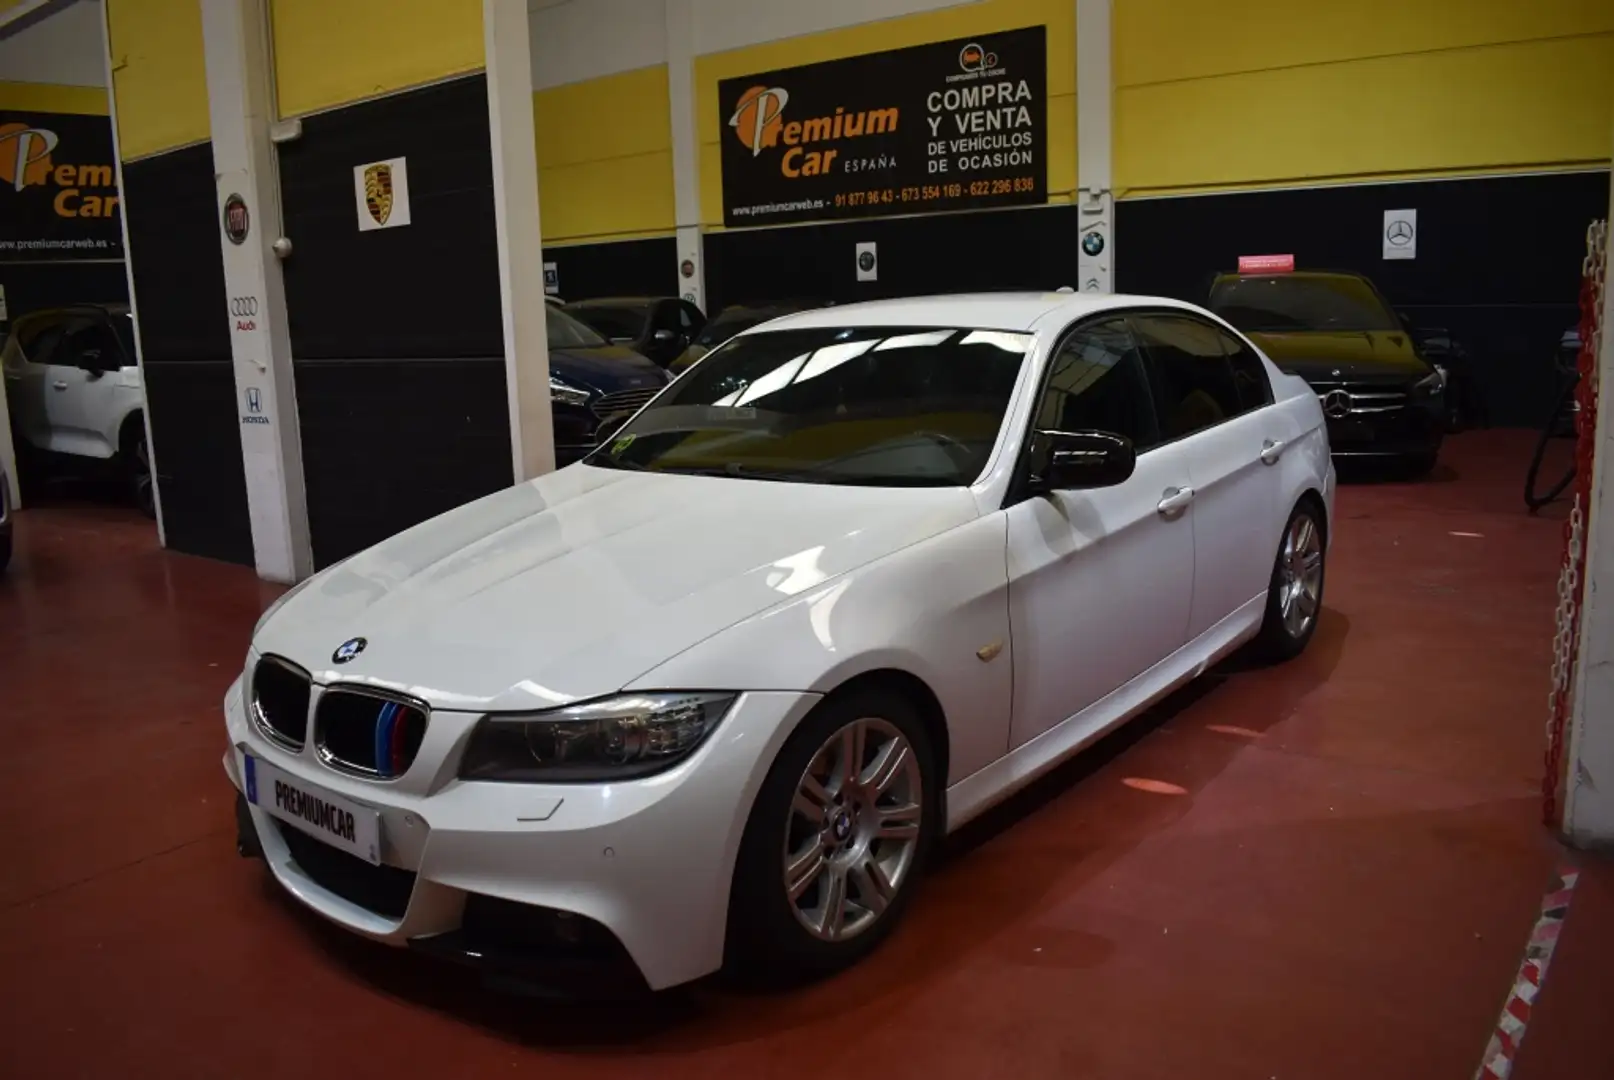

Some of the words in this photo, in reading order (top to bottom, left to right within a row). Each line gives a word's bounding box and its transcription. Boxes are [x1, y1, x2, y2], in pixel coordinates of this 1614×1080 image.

[927, 80, 1032, 113] COMPRA
[728, 87, 899, 158] Premium
[927, 116, 942, 137] Y
[955, 105, 1032, 134] VENTA
[928, 141, 946, 156] DE
[950, 131, 1032, 153] VEHÍCULOS
[0, 128, 117, 192] Prem
[781, 146, 838, 178] Car
[844, 153, 897, 173] ESPAÑA
[928, 159, 948, 173] DE
[958, 149, 1032, 170] OCASIÓN
[54, 188, 119, 218] Car
[848, 192, 865, 206] 877
[881, 189, 893, 203] 43
[922, 184, 940, 199] 554
[970, 181, 990, 196] 622
[236, 320, 256, 332] Audi
[242, 416, 270, 425] HONDA
[275, 780, 356, 843] PREMIUMCAR
